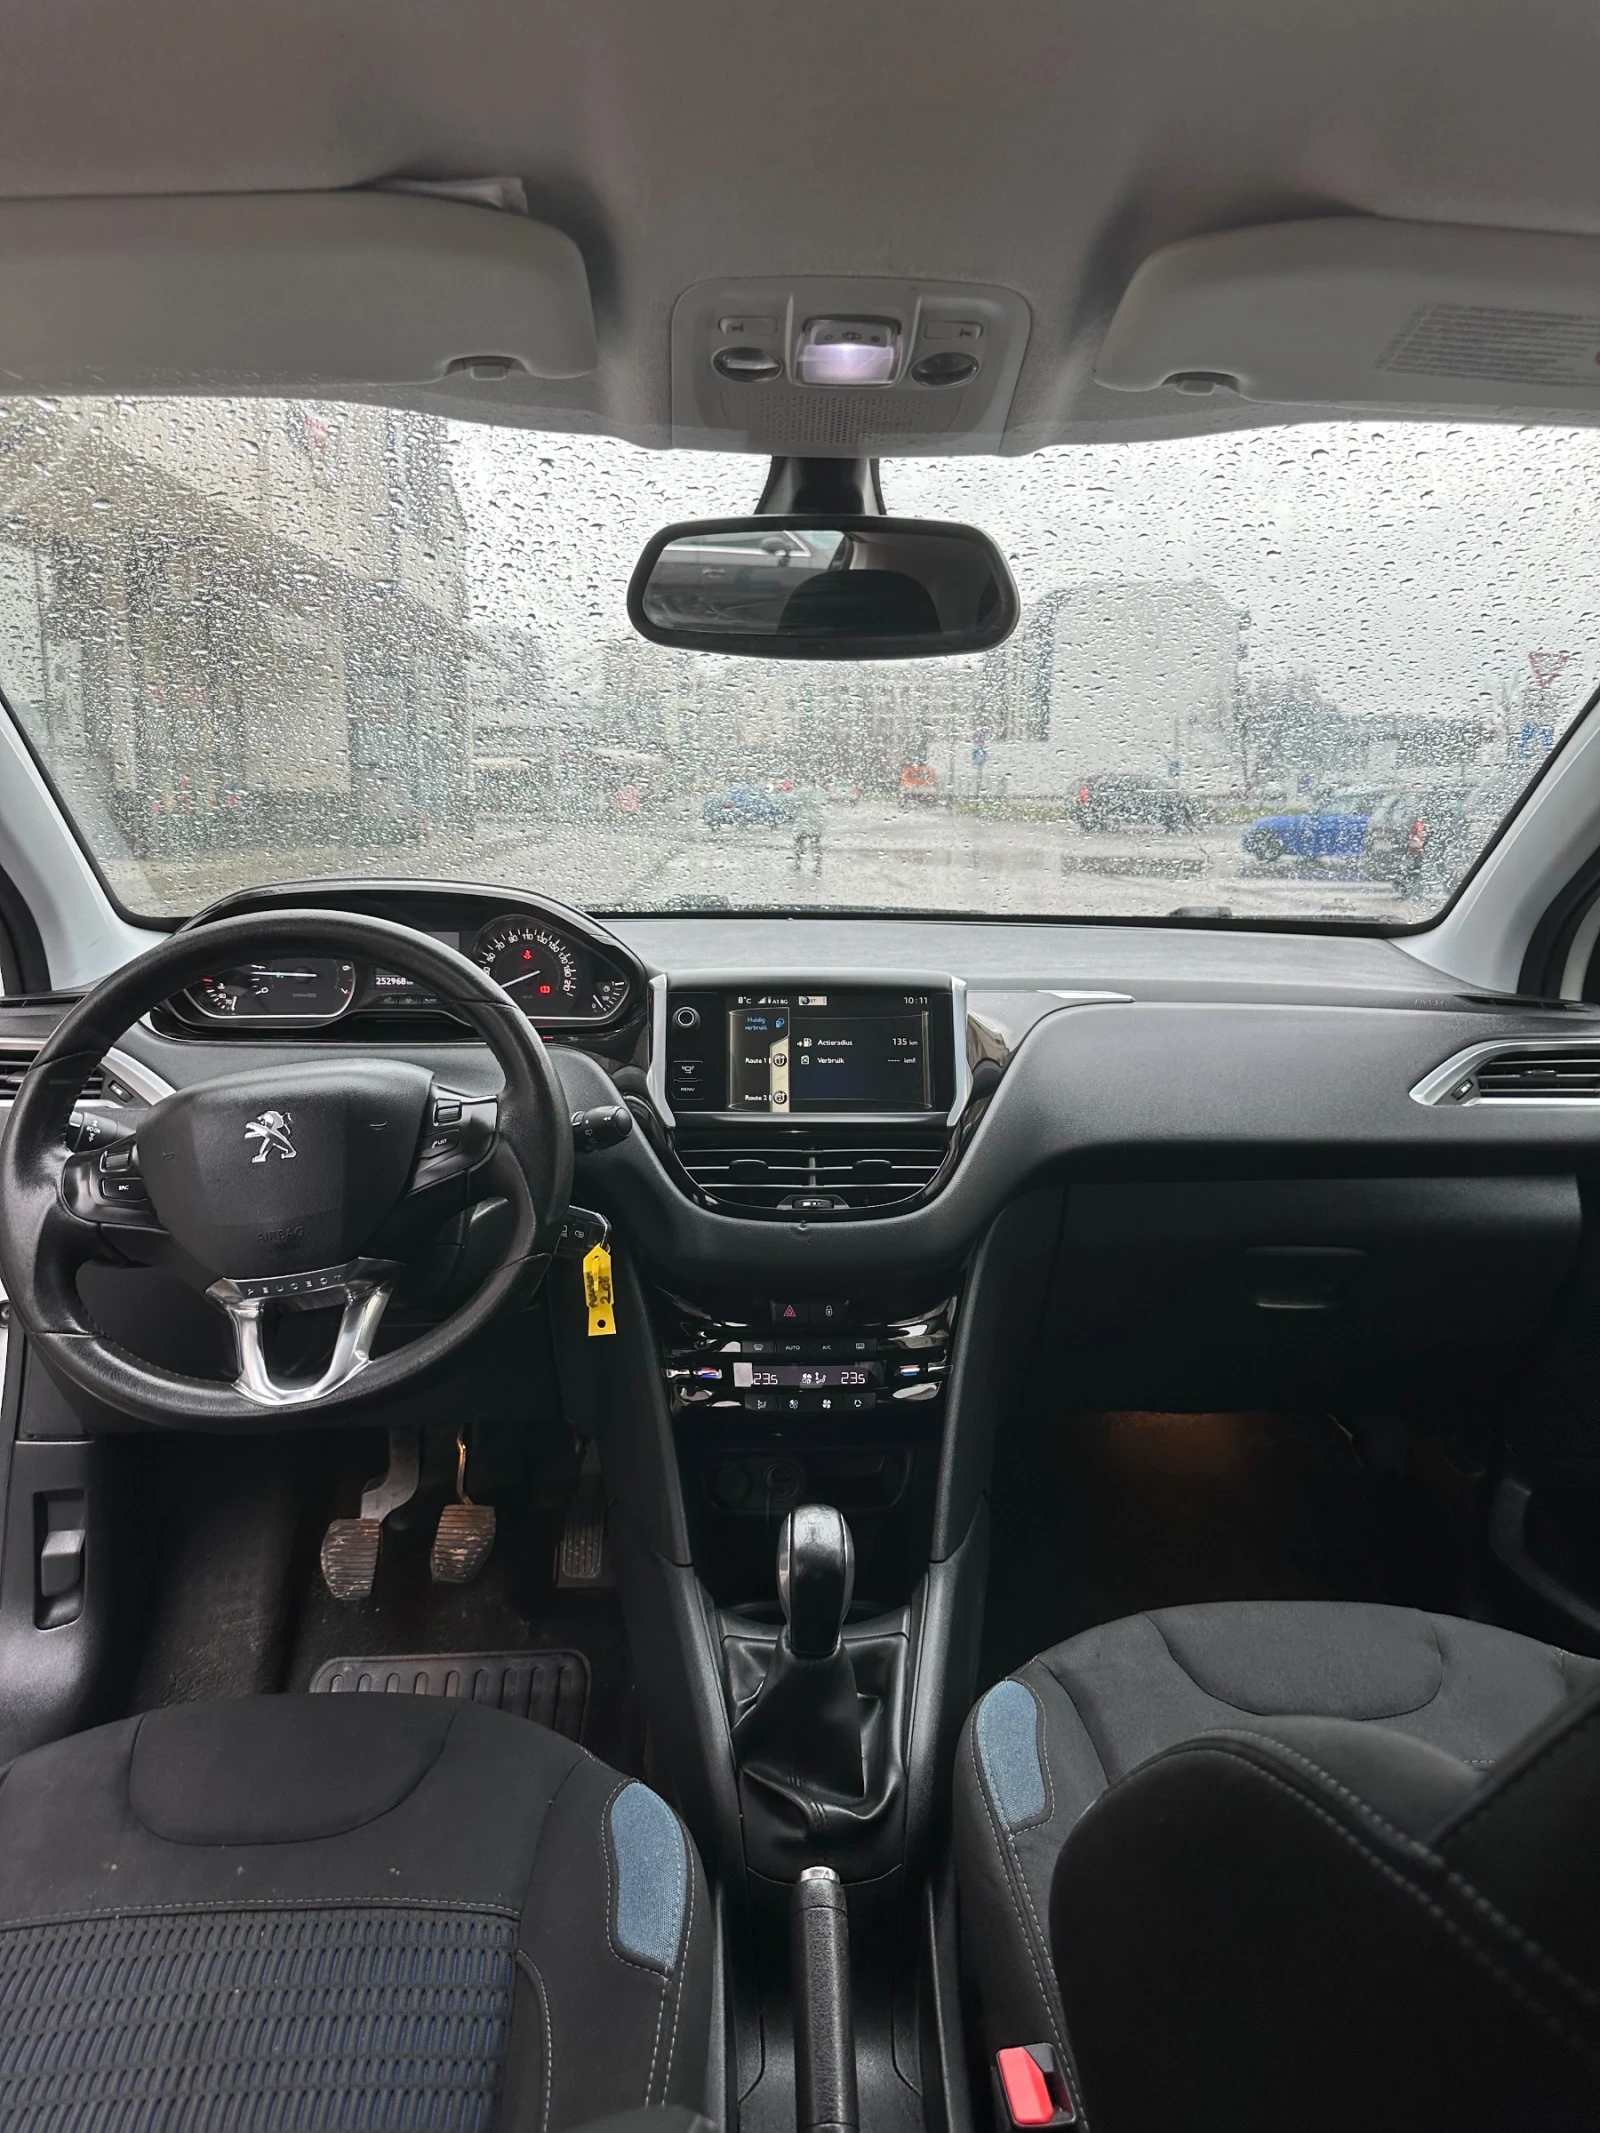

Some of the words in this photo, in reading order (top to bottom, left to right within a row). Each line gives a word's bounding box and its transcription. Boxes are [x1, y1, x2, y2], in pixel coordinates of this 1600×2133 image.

[522, 933, 534, 941] 110
[536, 935, 548, 945] 130
[495, 941, 506, 951] 70
[558, 952, 568, 964] 170
[375, 977, 407, 986] 252968
[903, 996, 929, 1005] 10:11
[817, 1039, 853, 1047] Actieradius
[892, 1037, 908, 1046] 135
[745, 1057, 762, 1065] Route
[817, 1057, 845, 1065] Verbruik
[257, 1225, 305, 1244] AIRBAG
[247, 1274, 342, 1296] PEUGEOT
